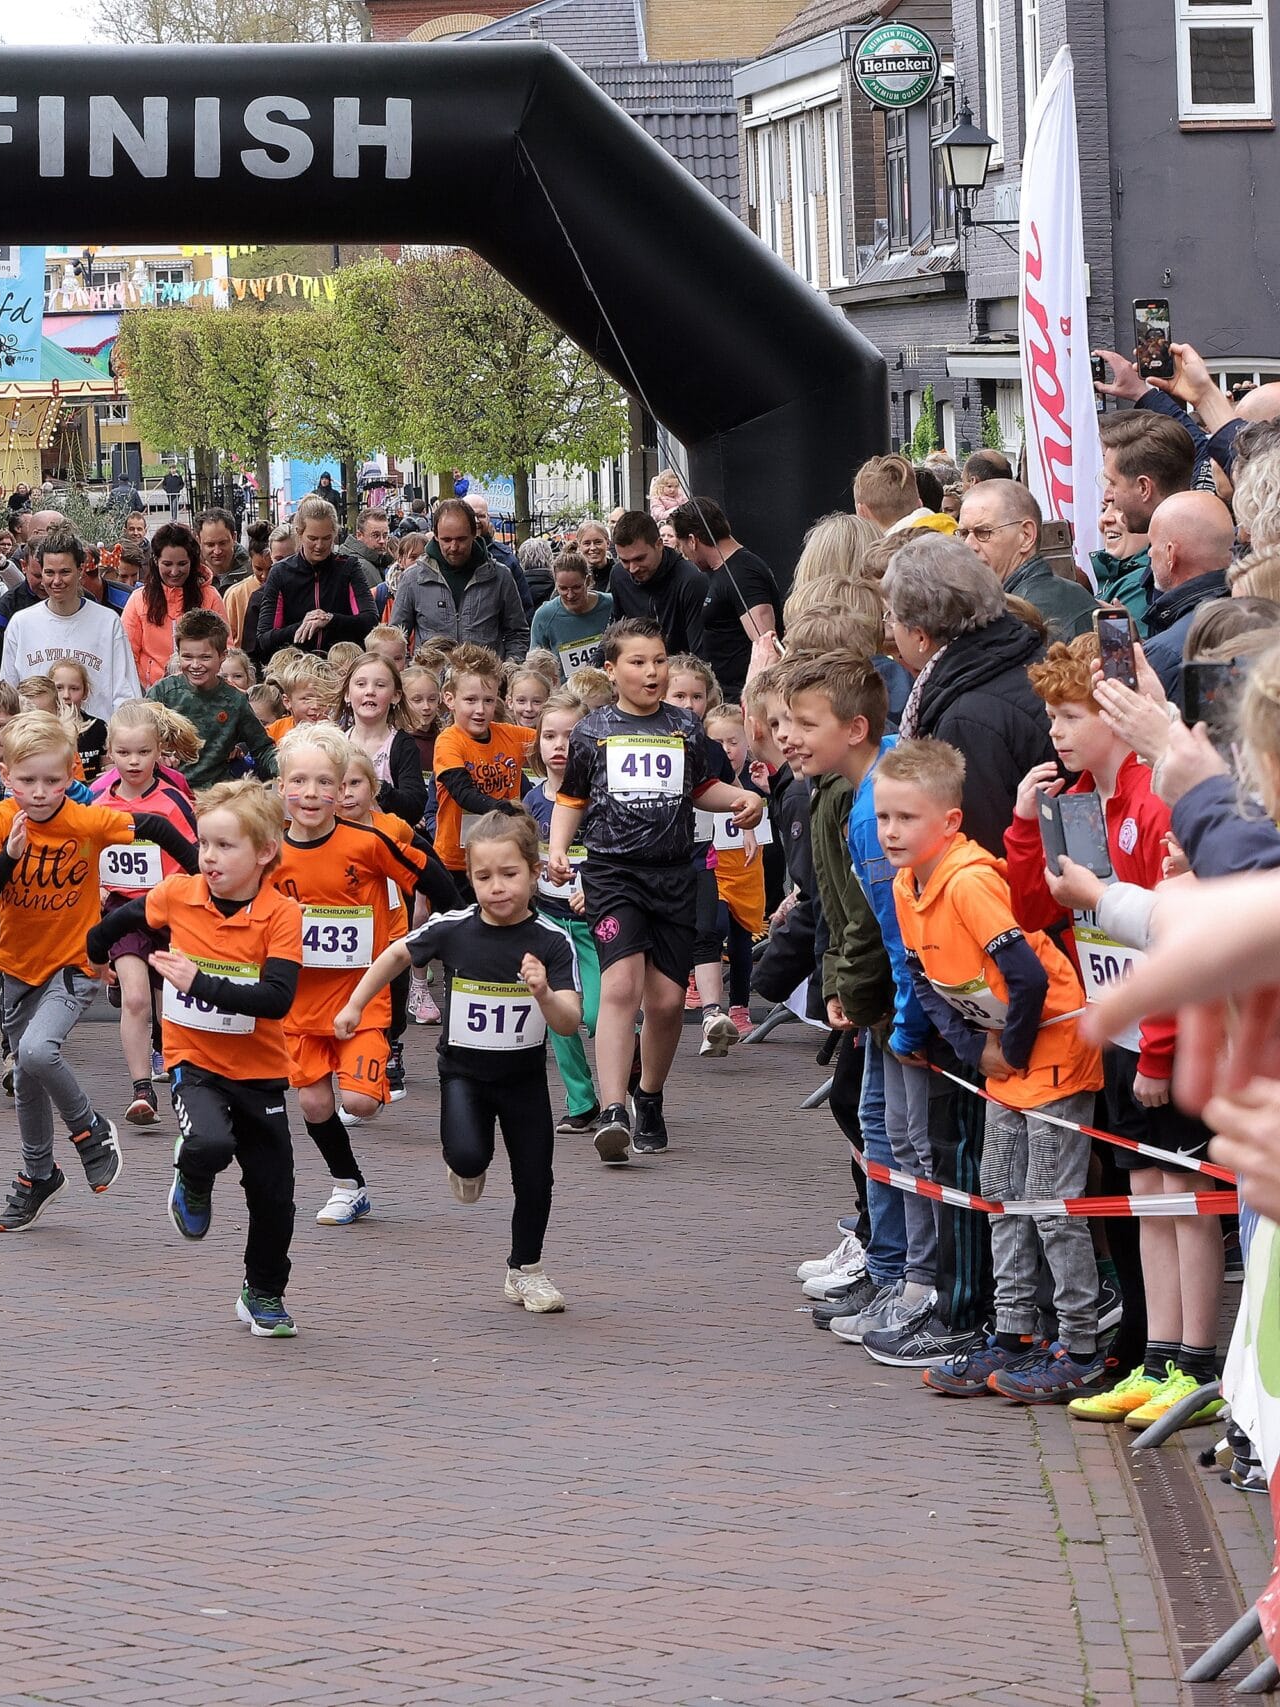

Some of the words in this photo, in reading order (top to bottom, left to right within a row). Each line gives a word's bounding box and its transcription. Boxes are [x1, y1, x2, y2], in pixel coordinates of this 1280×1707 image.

[868, 31, 896, 51] HEINEKEN
[896, 30, 924, 49] PILSENER
[863, 57, 930, 73] Heineken
[869, 81, 900, 100] PREMIUM
[901, 80, 926, 100] QUALITY
[26, 650, 45, 667] LA
[45, 648, 103, 671] VILLETTE
[476, 762, 503, 780] CODE
[621, 752, 672, 779] 419
[626, 800, 653, 810] rent
[107, 850, 149, 876] 395
[302, 925, 359, 953] 433
[467, 1002, 532, 1034] 517
[353, 1055, 380, 1083] 10
